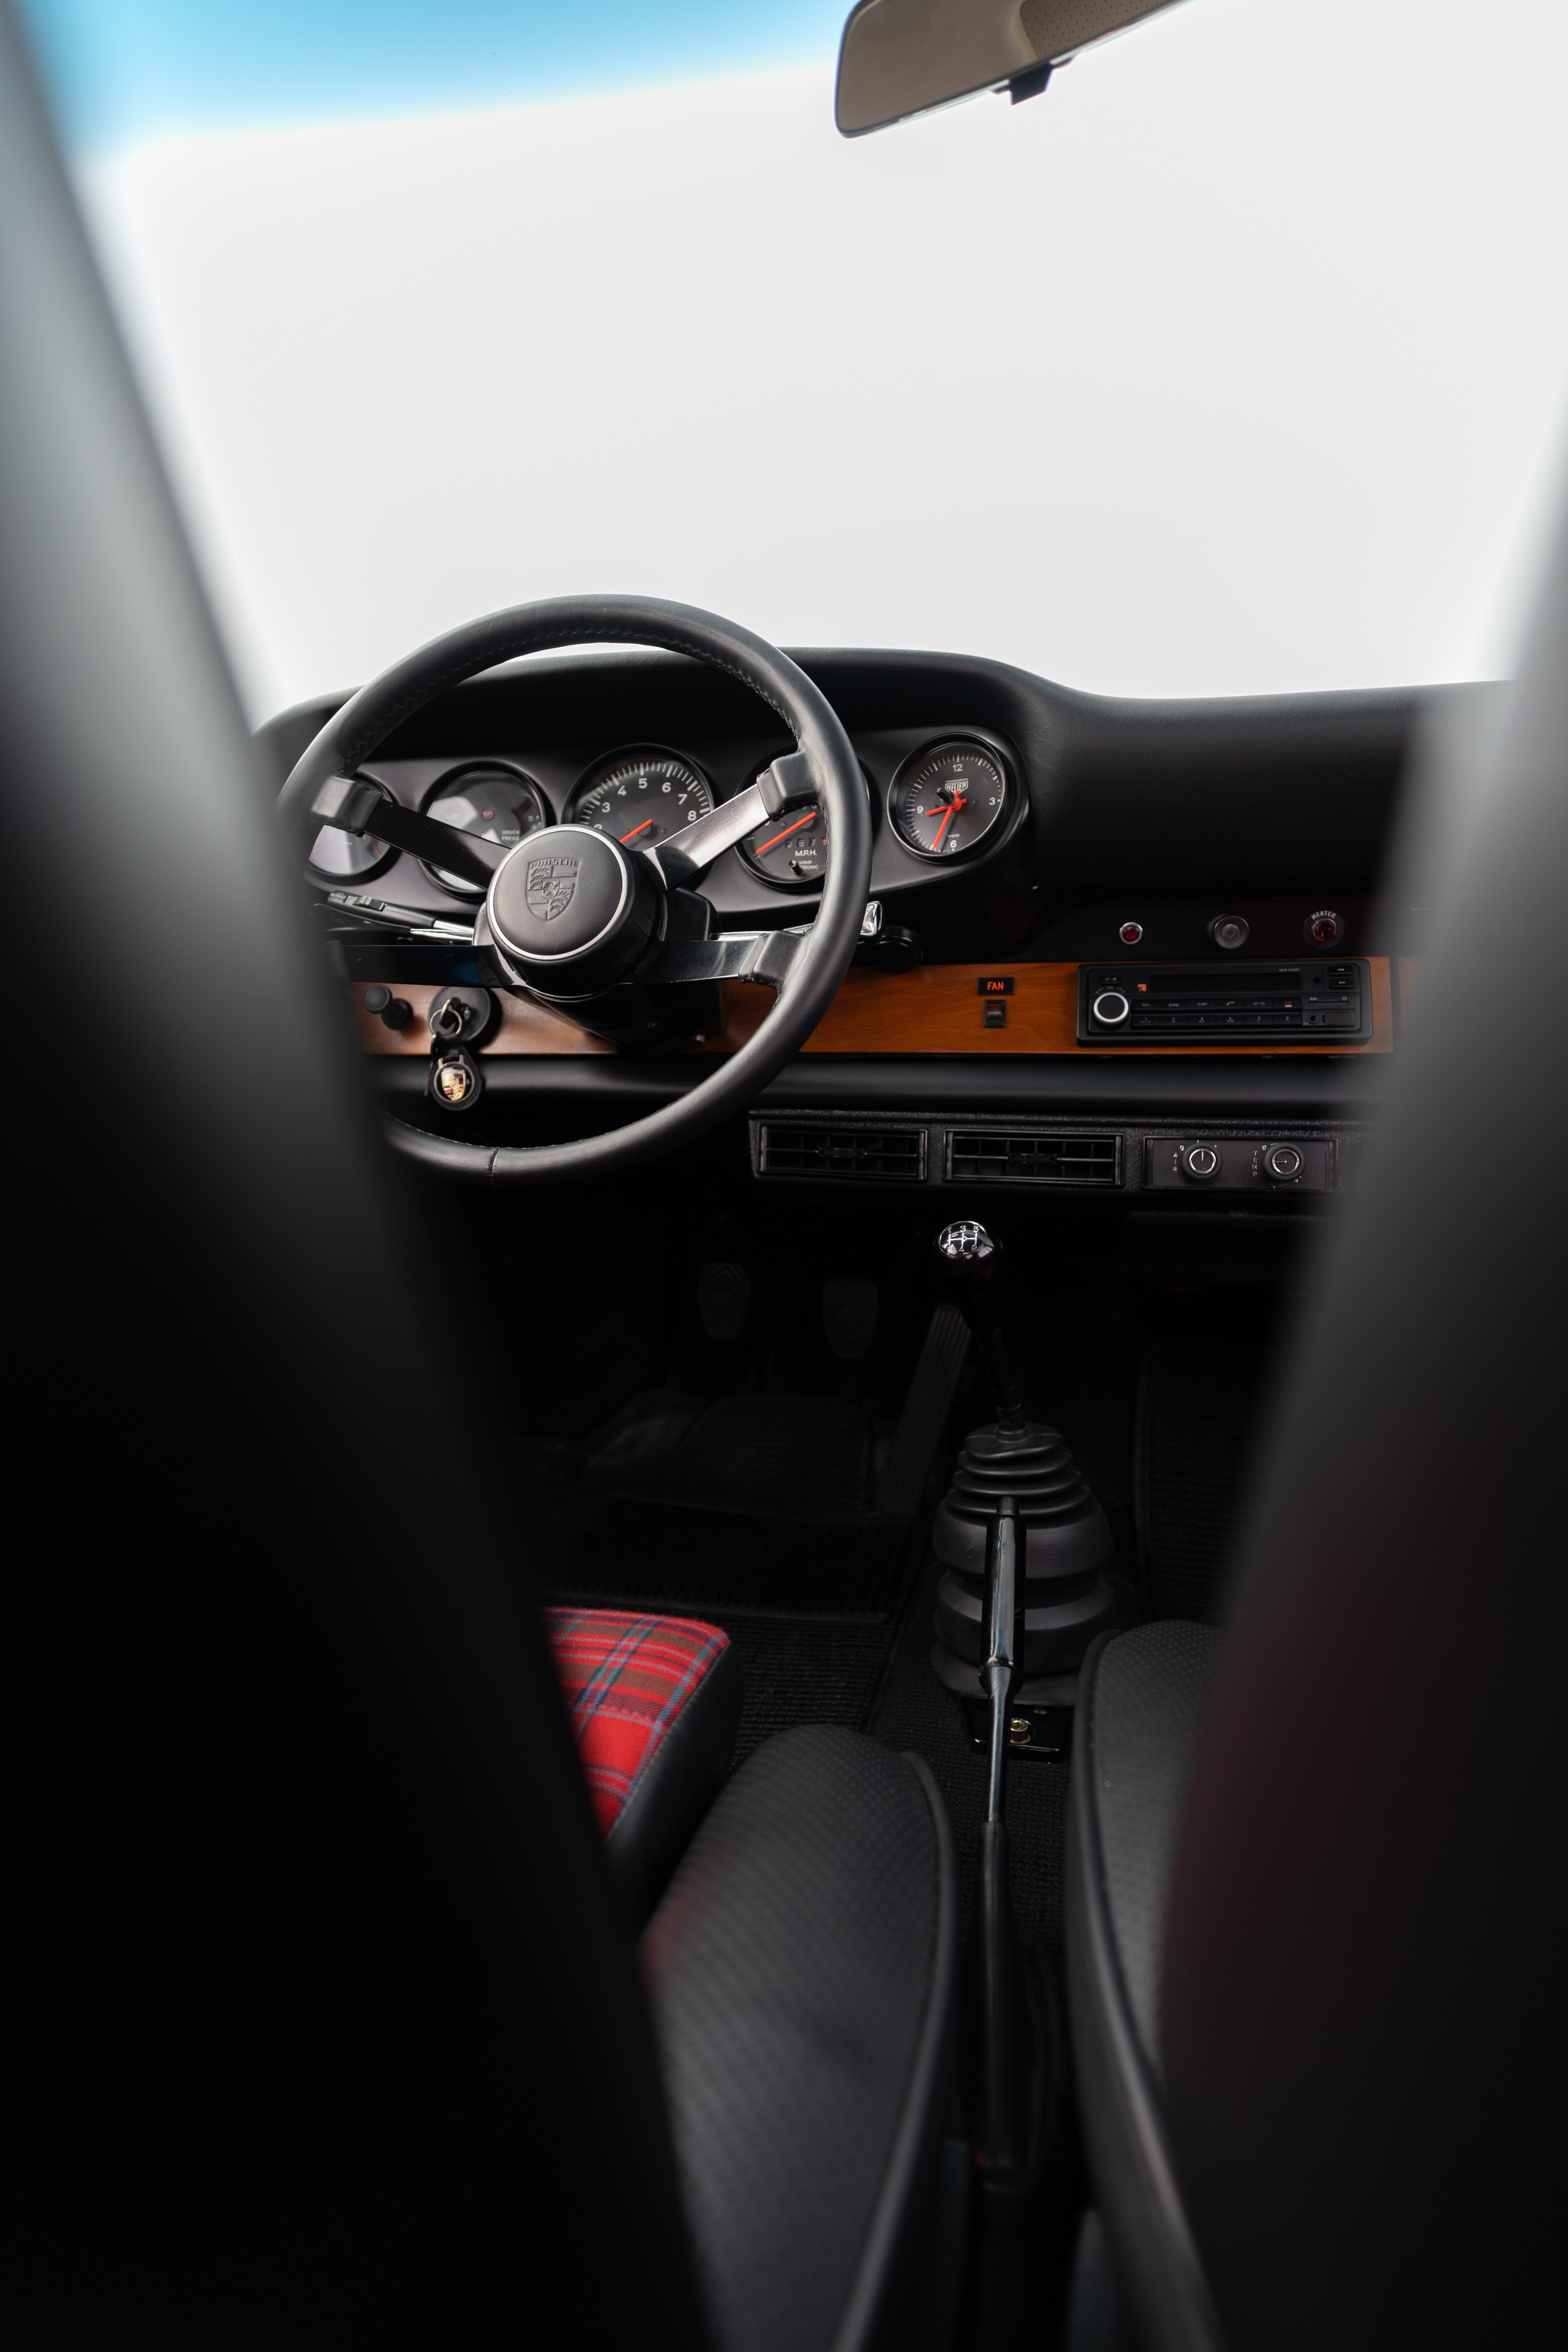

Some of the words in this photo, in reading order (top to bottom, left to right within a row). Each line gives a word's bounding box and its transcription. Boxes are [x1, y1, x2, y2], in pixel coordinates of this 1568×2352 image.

[952, 764, 963, 772] 12
[638, 778, 647, 789] 5
[662, 782, 671, 793] 6
[617, 786, 627, 796] 4
[678, 793, 687, 804] 7
[989, 797, 996, 806] 3
[601, 802, 610, 813] 3
[687, 810, 697, 821] 8
[950, 840, 957, 848] 6
[530, 858, 579, 869] PORSCHE
[1311, 910, 1336, 920] HEATER
[987, 981, 1004, 991] FAN
